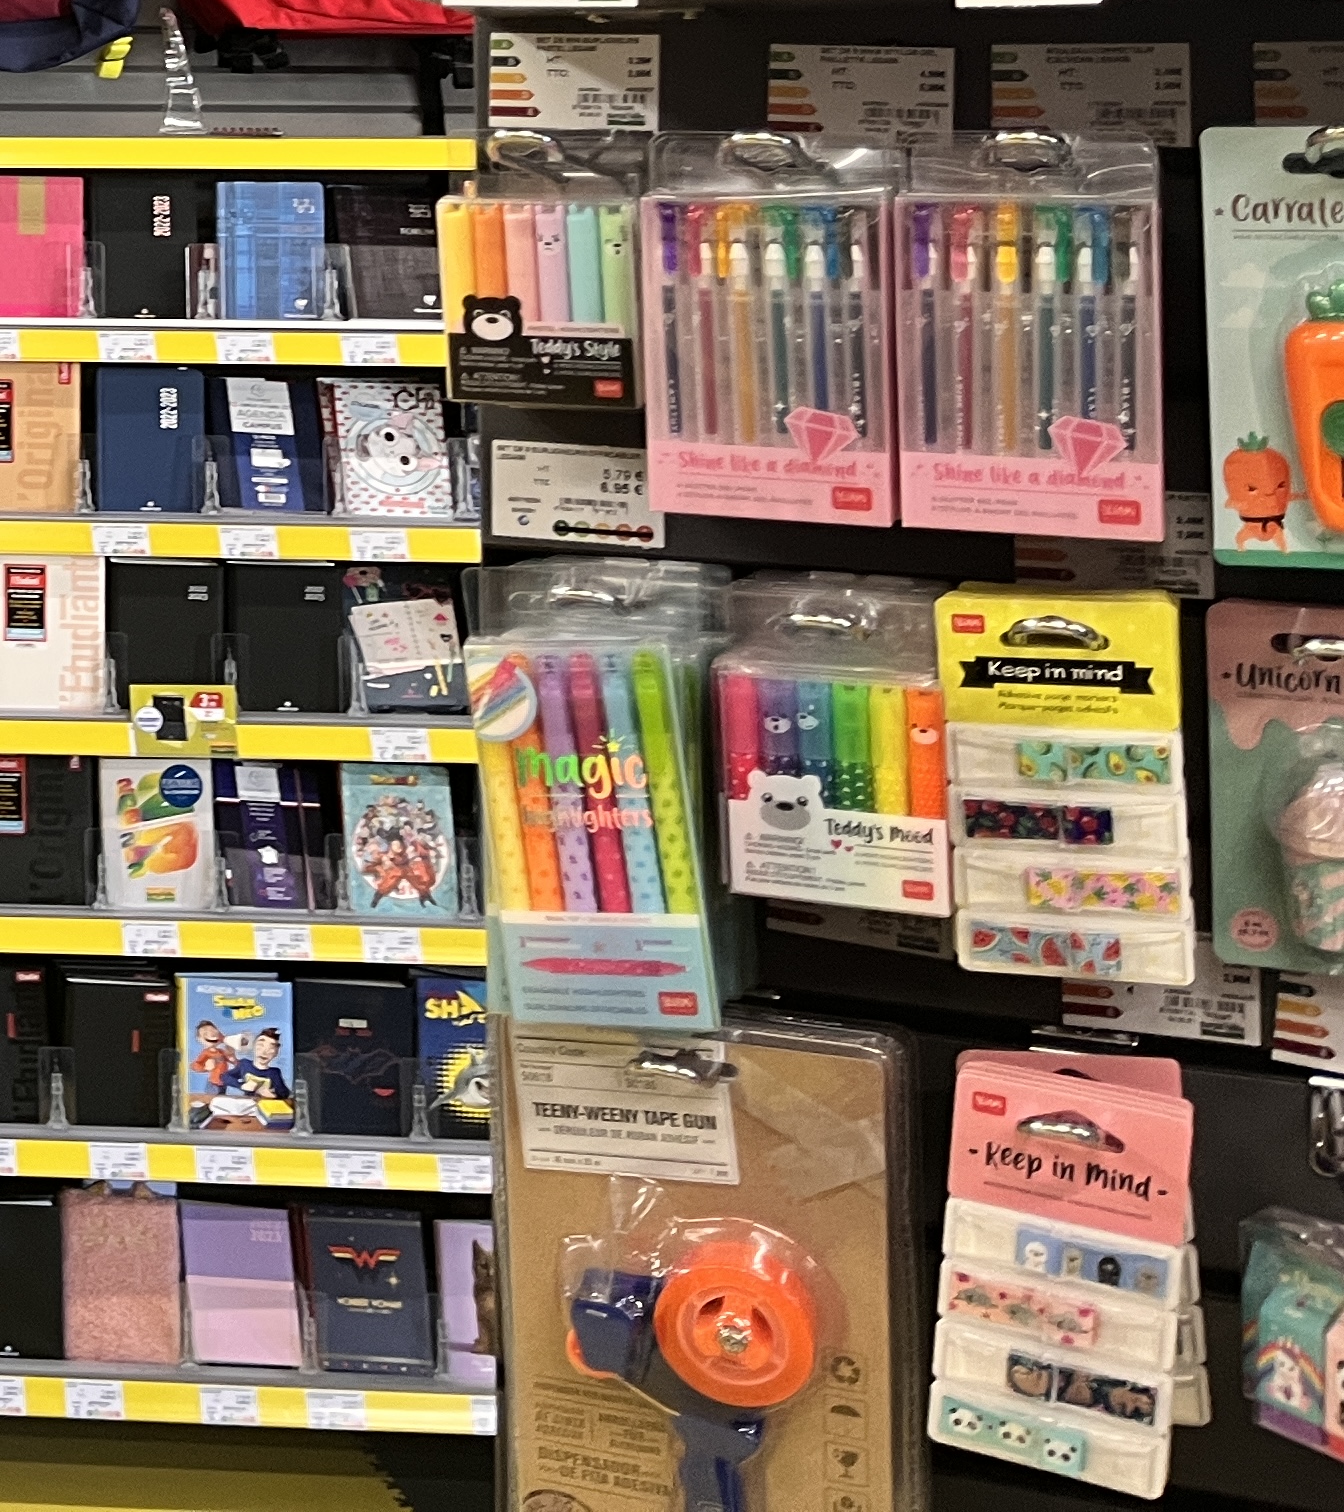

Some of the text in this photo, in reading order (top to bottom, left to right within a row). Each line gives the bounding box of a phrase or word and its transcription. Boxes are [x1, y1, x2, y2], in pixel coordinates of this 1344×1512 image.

[529, 338, 582, 359] Teddy's
[584, 341, 622, 359] Style
[932, 462, 982, 482] Shine
[989, 465, 1024, 485] like
[1028, 472, 1041, 485] a
[987, 659, 1124, 683] Keep in mind
[1235, 661, 1342, 692] Unicorn
[516, 743, 648, 799] magic
[823, 818, 885, 843] Teddy's
[531, 1101, 718, 1130] TEENY-WEENY TAPE GUN
[984, 1140, 1044, 1181] Keep
[1051, 1154, 1076, 1183] in
